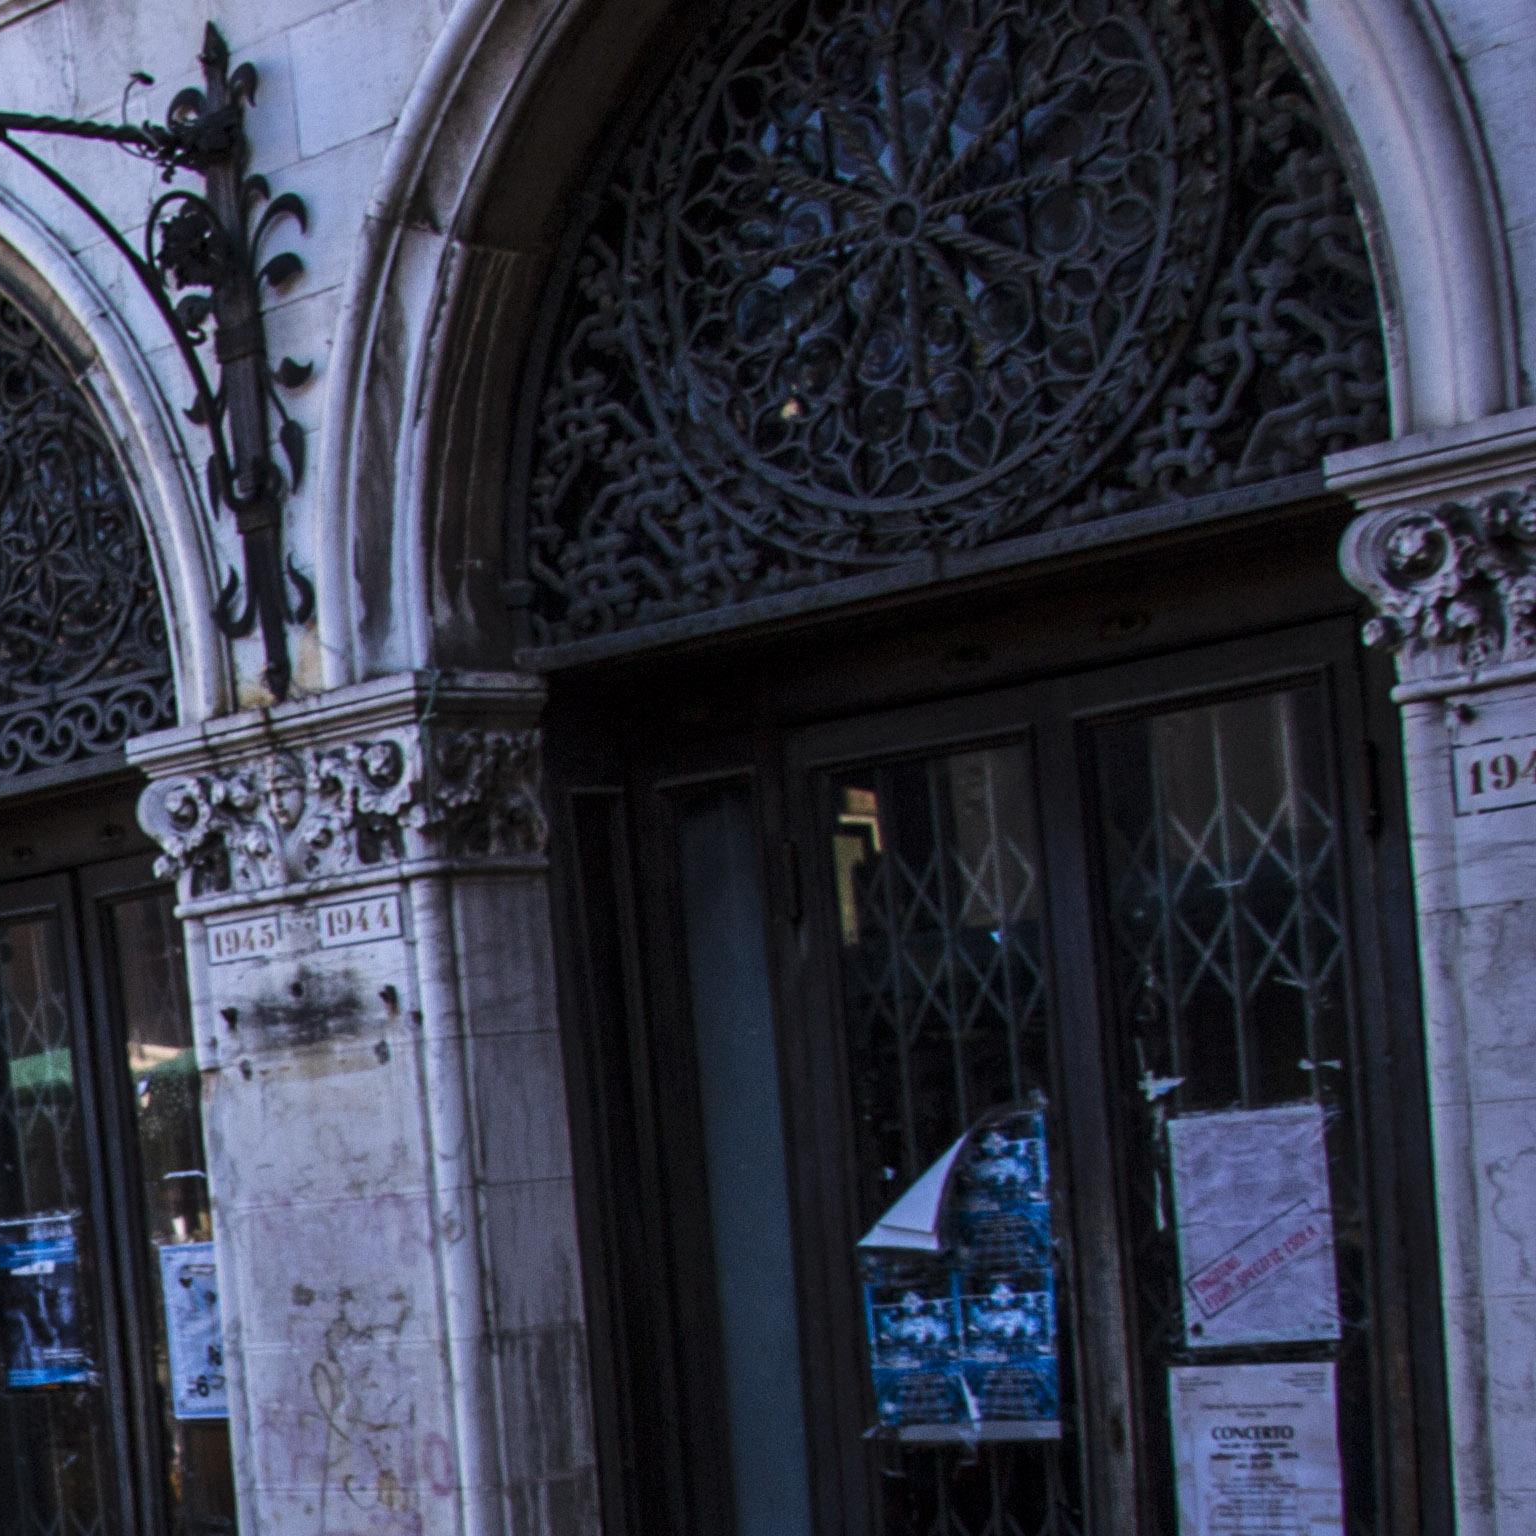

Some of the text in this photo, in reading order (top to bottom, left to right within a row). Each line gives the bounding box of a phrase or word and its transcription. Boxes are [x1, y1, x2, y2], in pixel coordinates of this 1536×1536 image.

[327, 903, 390, 938] 1944
[212, 924, 276, 957] 1945
[1211, 1425, 1295, 1441] CONCERTO
